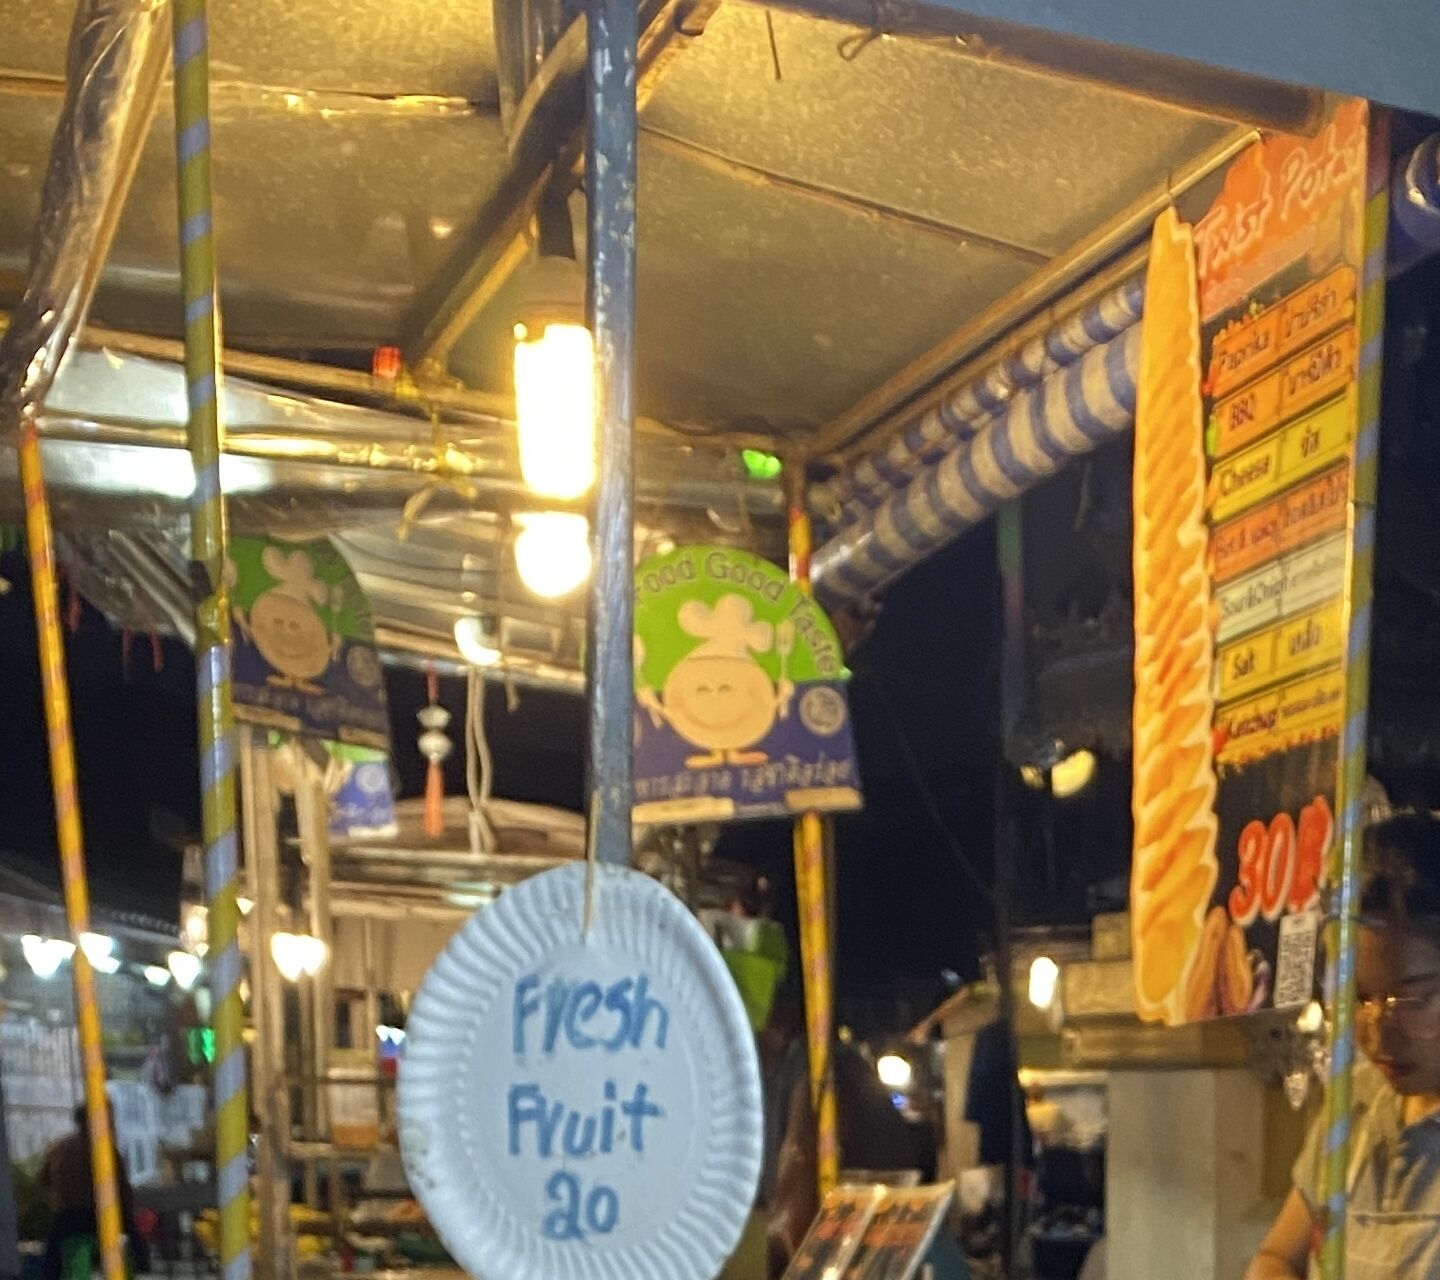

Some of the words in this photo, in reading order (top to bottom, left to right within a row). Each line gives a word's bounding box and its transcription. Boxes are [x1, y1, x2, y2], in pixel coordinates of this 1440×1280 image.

[1229, 391, 1256, 432] BBQ
[1221, 452, 1273, 498] Cheese
[705, 552, 784, 600] Good
[789, 598, 836, 676] Taste
[514, 971, 670, 1056] Fresh
[508, 1079, 667, 1157] Fruit
[543, 1171, 619, 1242] 20
